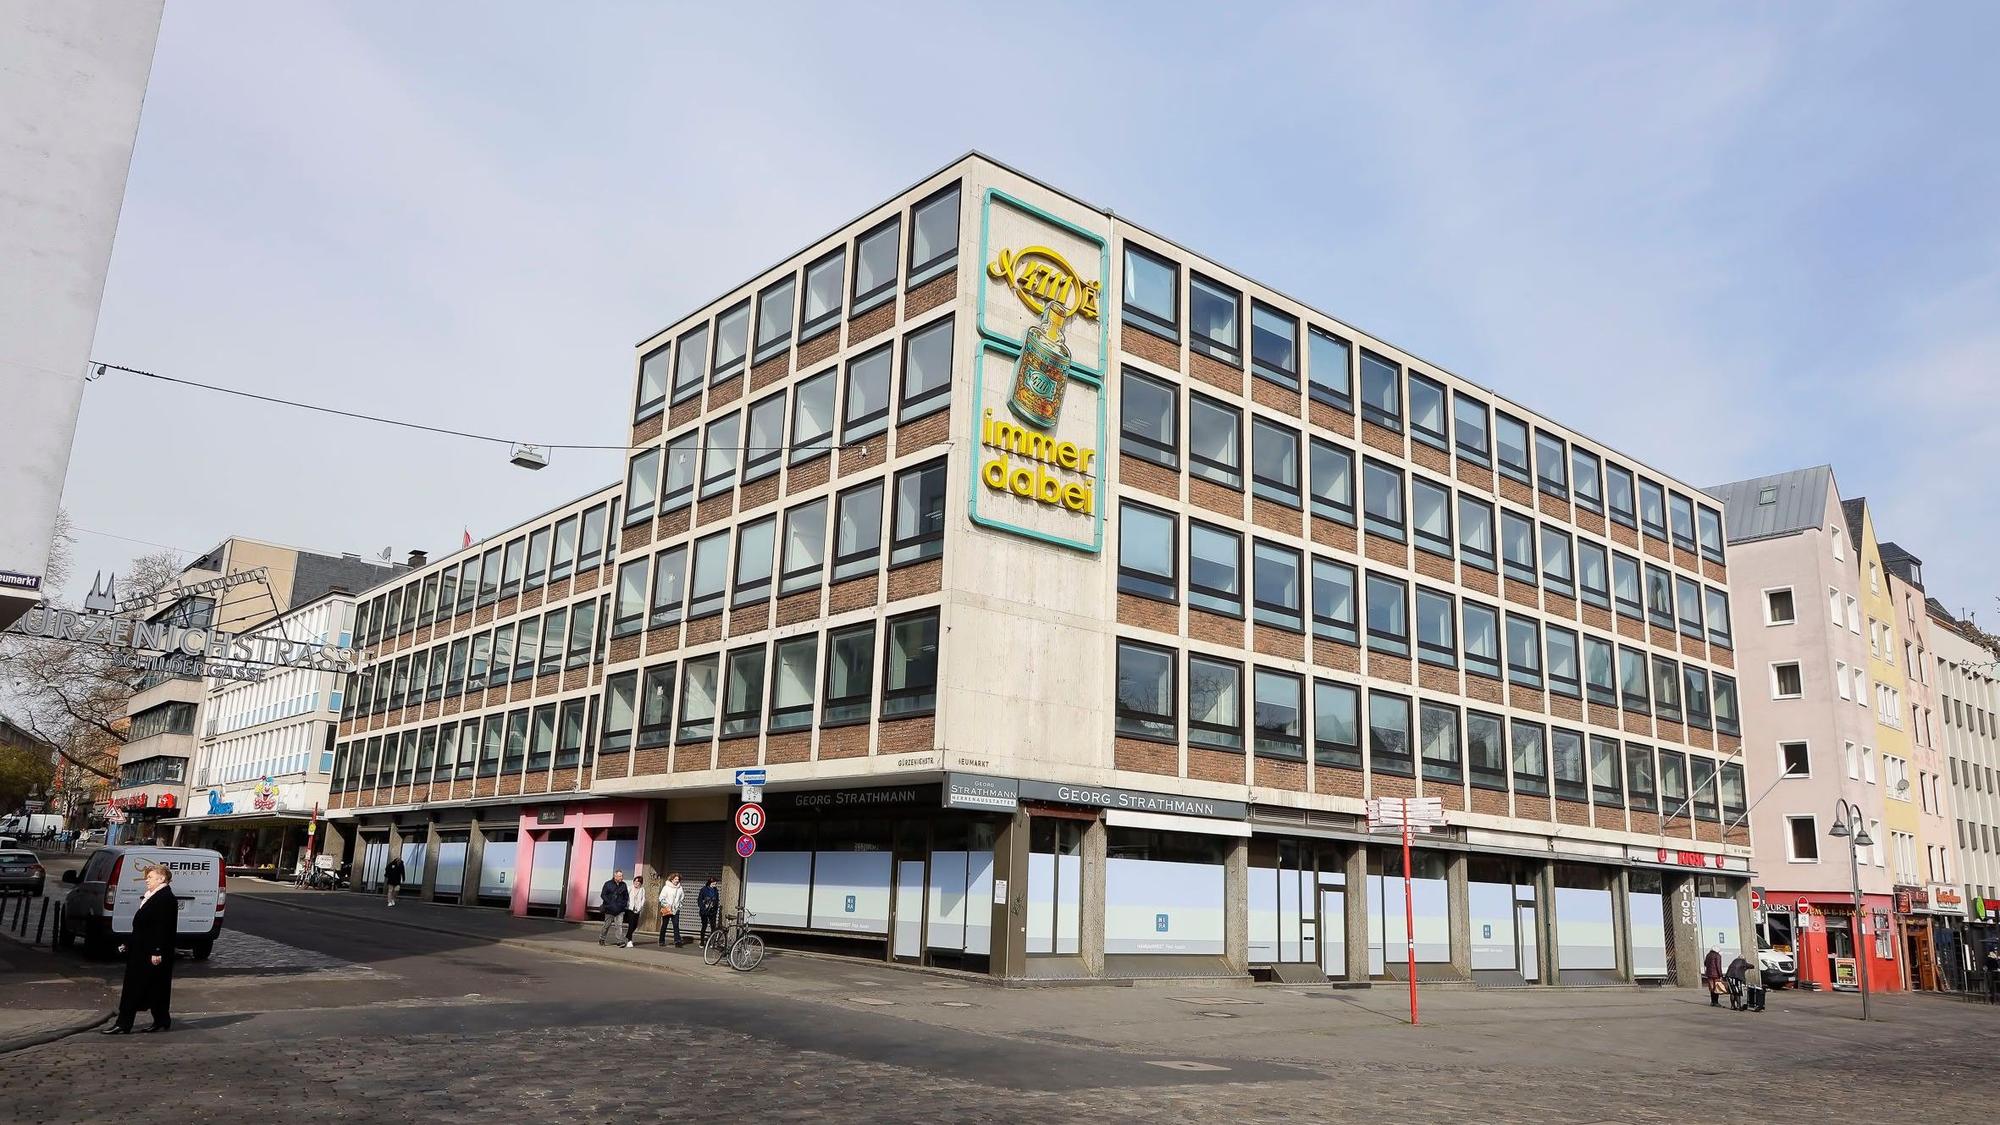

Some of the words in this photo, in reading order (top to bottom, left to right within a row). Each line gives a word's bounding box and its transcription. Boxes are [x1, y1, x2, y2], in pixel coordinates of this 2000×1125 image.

[1017, 261, 1074, 304] 4711
[983, 408, 1095, 474] immer
[983, 454, 1093, 514] dabei
[169, 566, 268, 598] shopping
[795, 795, 831, 806] GEORG
[835, 791, 916, 804] STRATHMANN
[951, 784, 1017, 798] STRATHMANN
[1058, 786, 1111, 804] GEORG
[1118, 793, 1214, 815] STRATHMANN
[742, 812, 759, 826] 30
[1677, 850, 1706, 867] KIOSK
[1680, 884, 1692, 925] KIOSK
